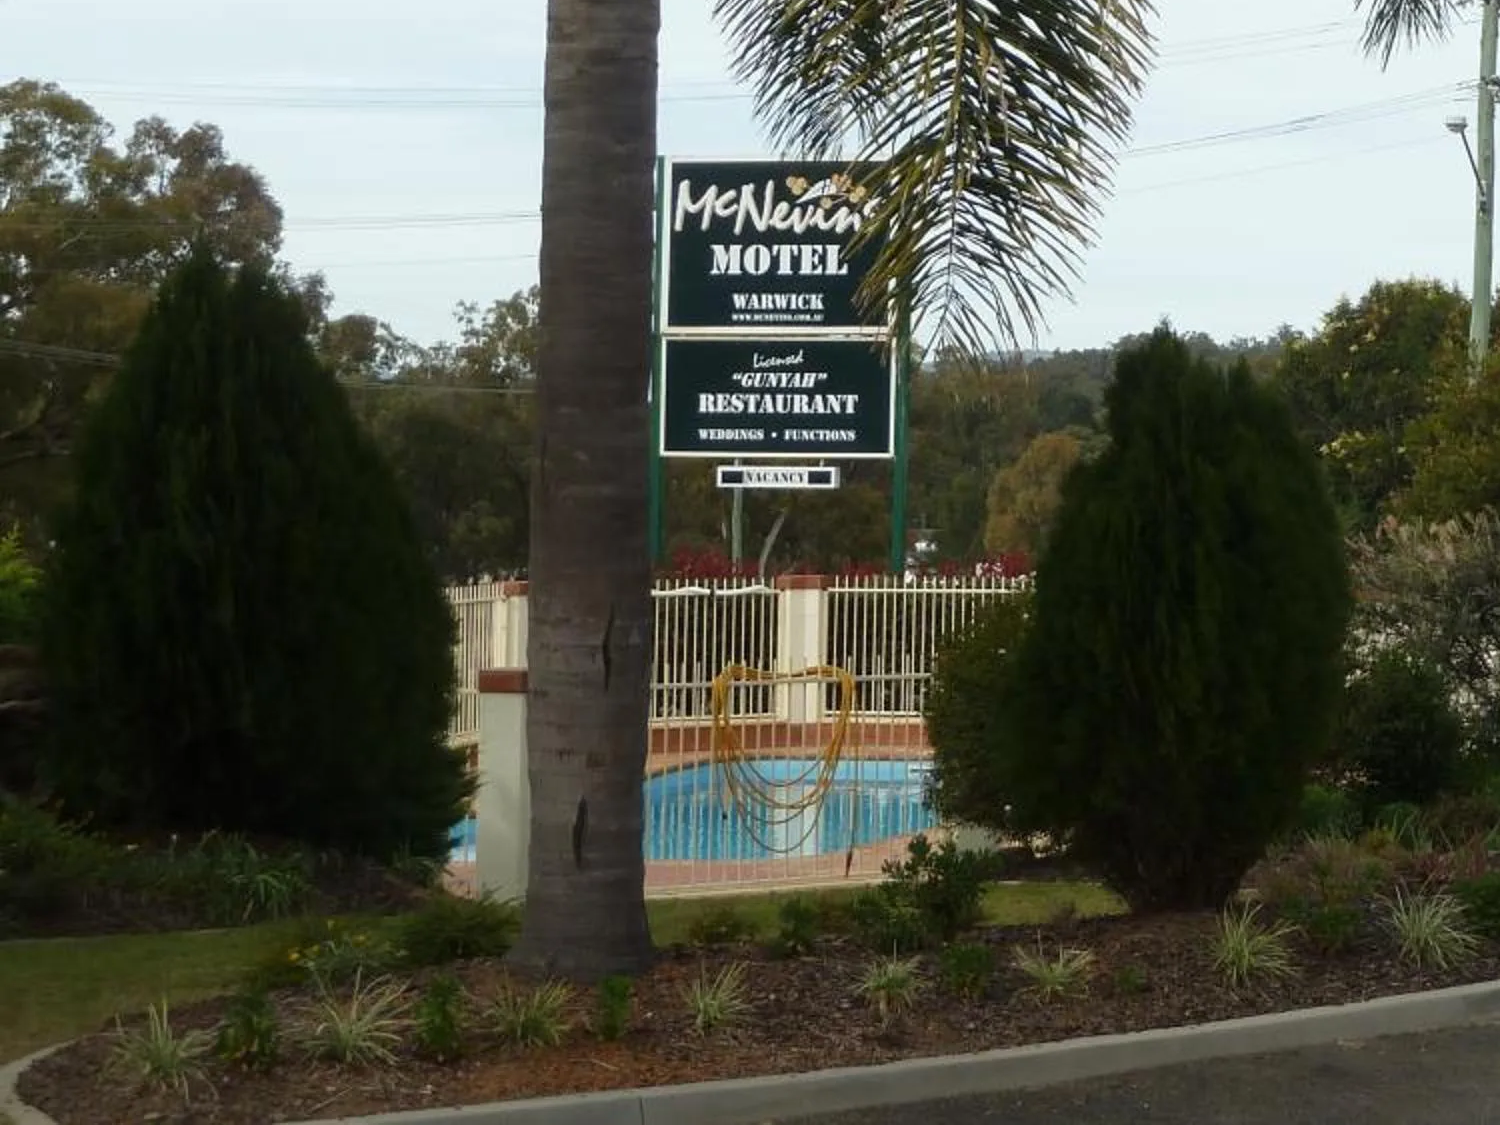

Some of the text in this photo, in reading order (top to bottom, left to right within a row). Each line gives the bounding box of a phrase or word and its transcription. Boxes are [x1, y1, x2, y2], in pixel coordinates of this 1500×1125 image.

[709, 244, 849, 275] MOTEL
[732, 293, 824, 309] WARWICK
[699, 394, 859, 414] RESTAURANT
[698, 429, 856, 442] WEDDINGS FUNCTIONS
[746, 470, 804, 484] VACANCY
